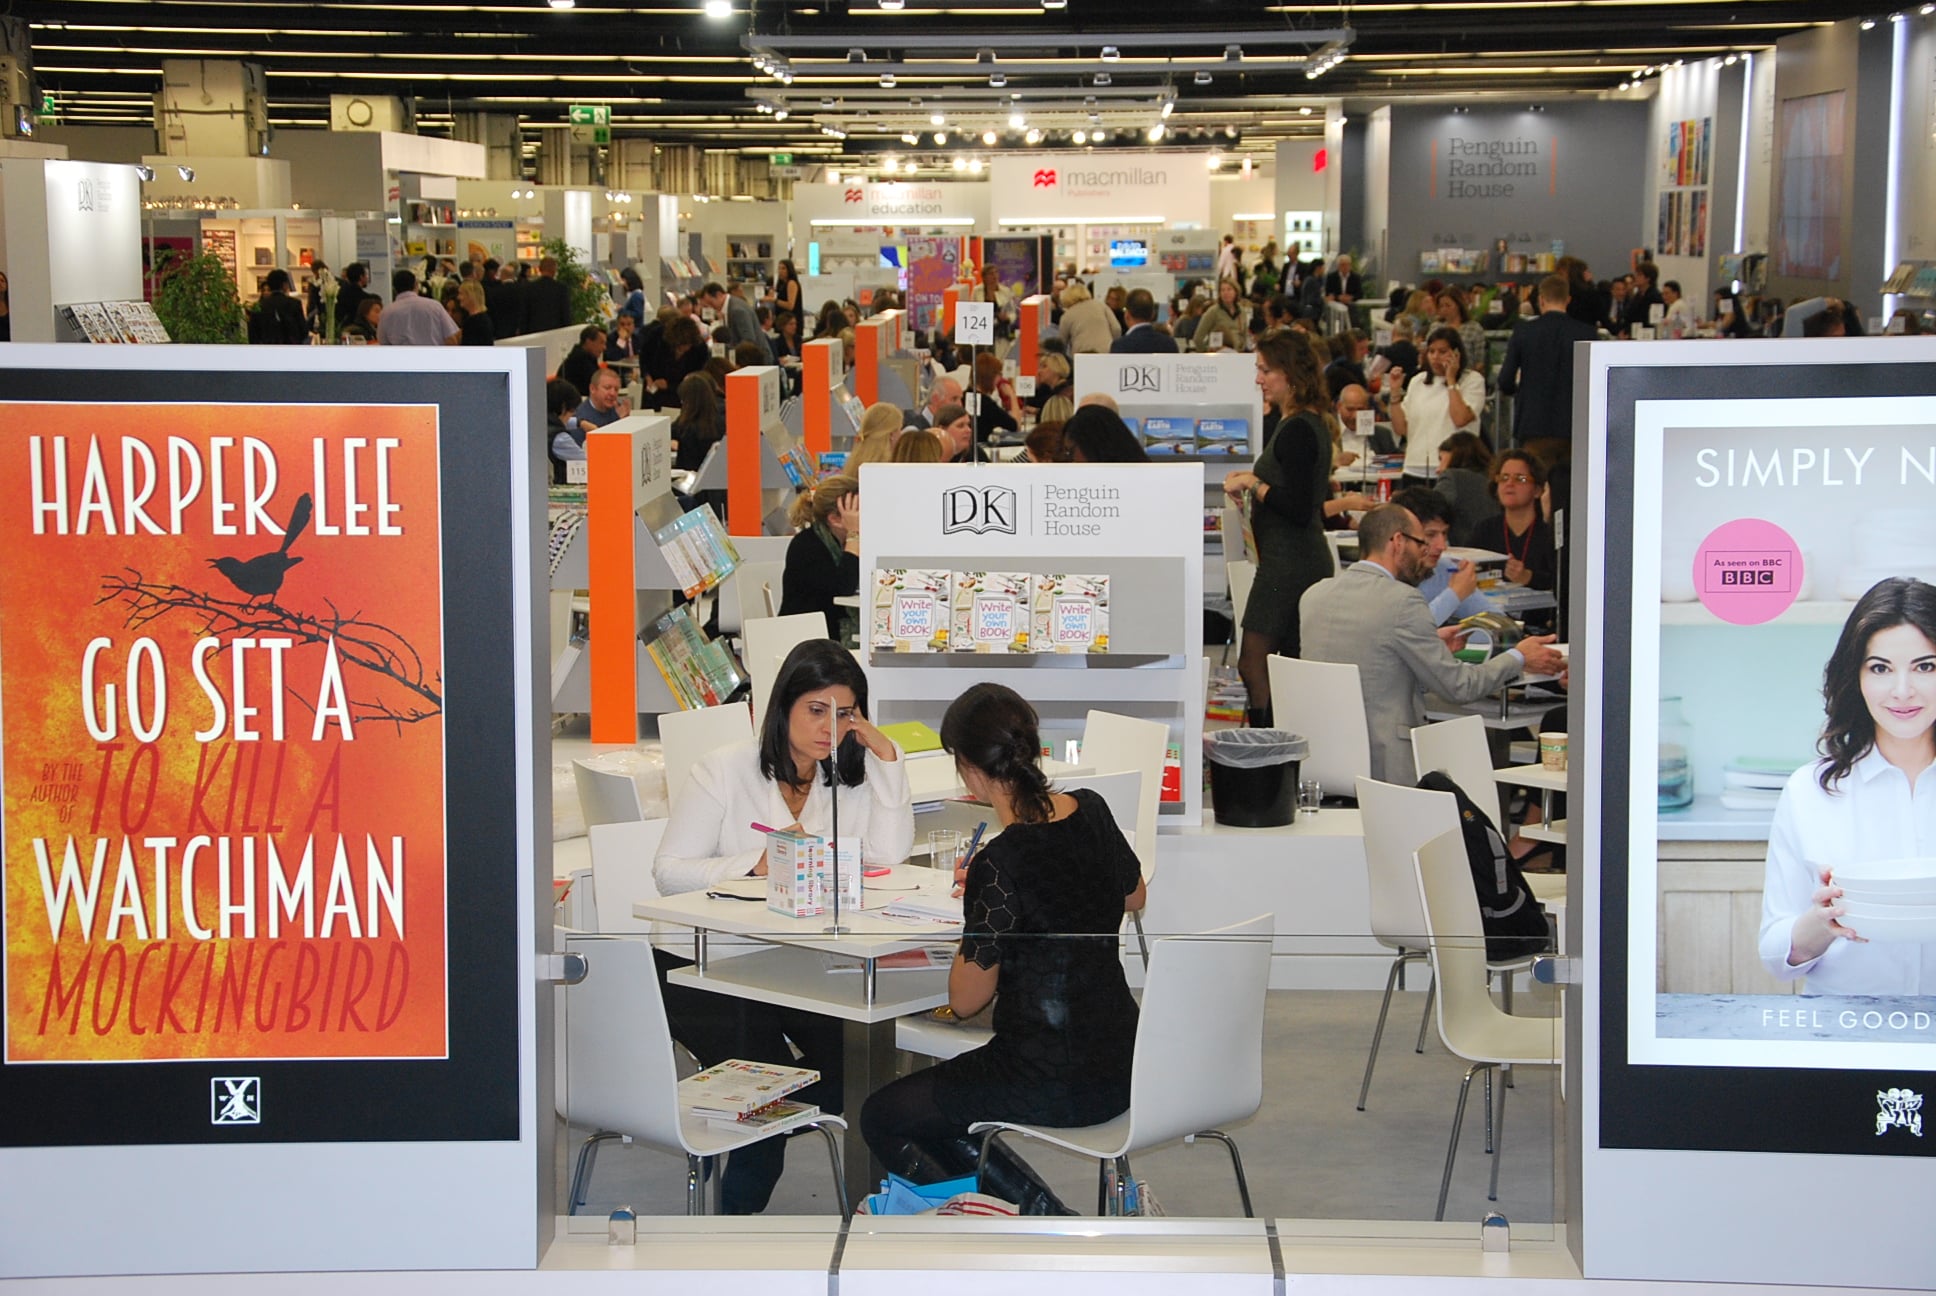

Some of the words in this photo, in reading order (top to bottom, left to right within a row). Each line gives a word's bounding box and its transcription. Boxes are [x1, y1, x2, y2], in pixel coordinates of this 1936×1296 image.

[1447, 135, 1538, 160] Penguin
[1447, 158, 1537, 177] Random
[1067, 167, 1167, 186] macmillan
[870, 187, 942, 200] mmillan
[1447, 180, 1515, 199] House
[871, 201, 942, 215] education
[963, 316, 987, 330] 124
[1124, 366, 1156, 387] DK
[1176, 363, 1218, 375] Penguin
[1176, 373, 1217, 383] Random
[1176, 384, 1207, 393] House
[1695, 447, 1875, 487] SIMPLY
[29, 434, 287, 535] HARPER
[313, 437, 403, 536] LEE
[1044, 484, 1120, 503] Penguin
[949, 489, 1009, 527] DK
[1044, 502, 1120, 518] Random
[1044, 521, 1101, 536] House
[1714, 559, 1725, 567] As
[1722, 571, 1773, 585] BBC
[900, 599, 932, 610] Write
[980, 602, 1013, 612] Write
[1060, 605, 1092, 615] Write
[902, 610, 928, 619] your
[905, 617, 927, 625] own
[982, 612, 1008, 621] your
[1062, 614, 1087, 623] your
[900, 625, 930, 635] BOOK
[980, 627, 1010, 637] BOOK
[1065, 622, 1087, 630] own
[1060, 630, 1089, 640] BOOK
[81, 636, 166, 743] GO
[191, 637, 293, 743] SET
[311, 634, 354, 741] A
[42, 762, 58, 781] BY
[62, 762, 83, 781] THE
[30, 784, 79, 802] AUTHOR
[89, 741, 161, 835] TO
[187, 741, 287, 834] KILL
[305, 741, 342, 833] A
[59, 804, 75, 824] OF
[807, 845, 815, 878] learning
[33, 832, 405, 944] WATCHMAN
[807, 879, 815, 906] library
[38, 941, 410, 1036] MOCKINGBIRD
[1762, 1009, 1823, 1028] FEEL
[1839, 1010, 1931, 1030] GOOD
